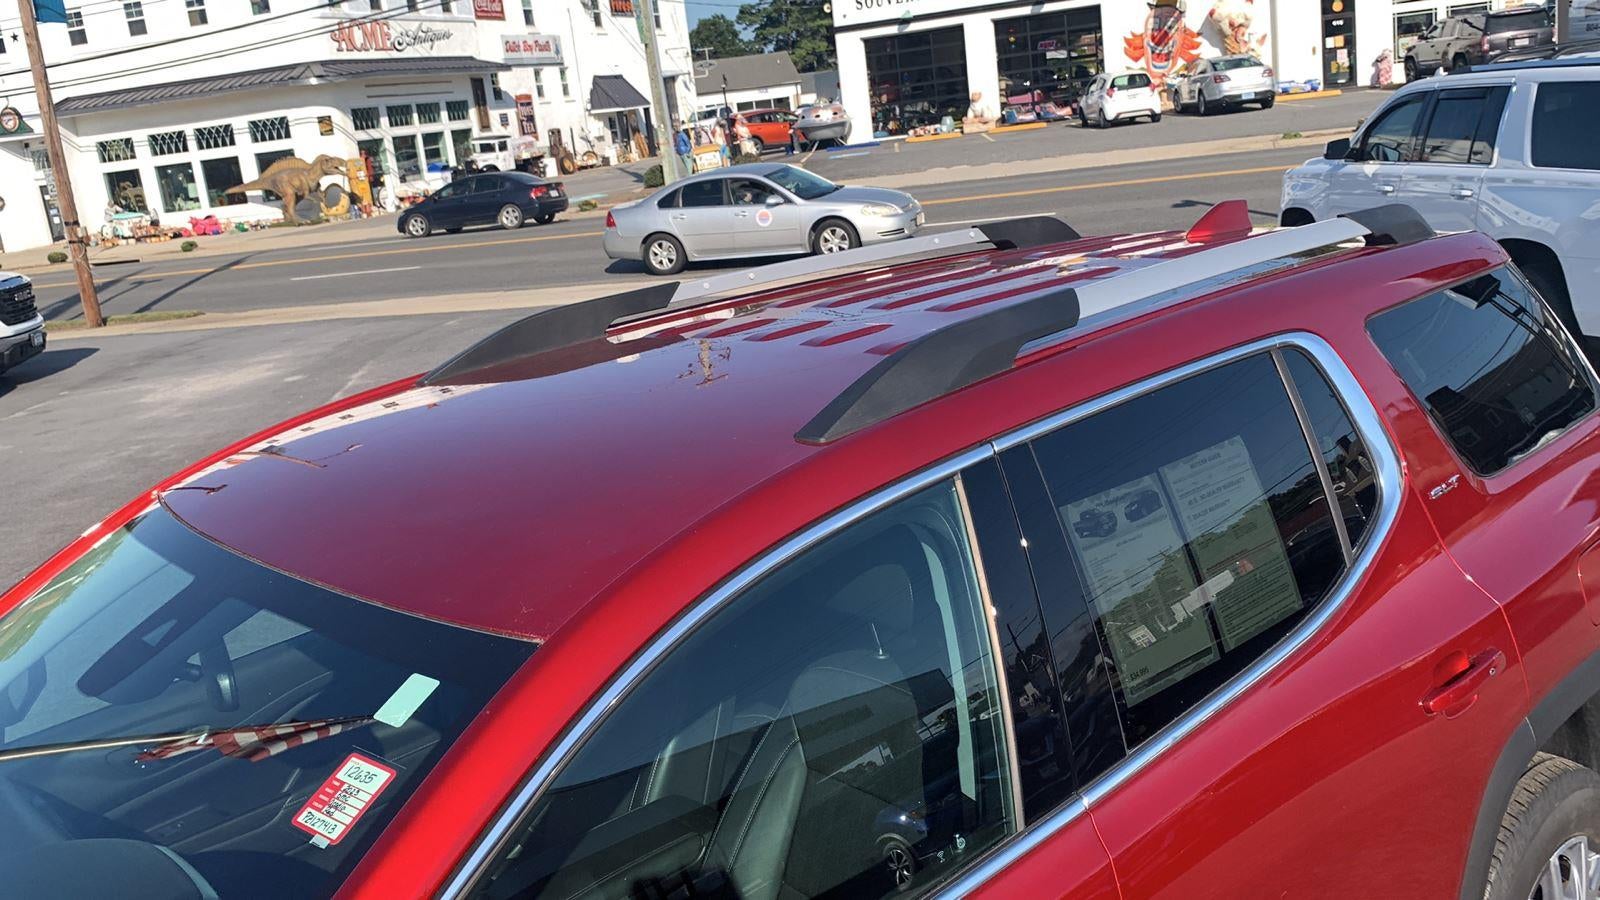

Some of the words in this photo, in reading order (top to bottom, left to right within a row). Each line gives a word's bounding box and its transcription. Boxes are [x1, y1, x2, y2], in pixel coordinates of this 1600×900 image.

[330, 19, 393, 52] ACME
[402, 22, 453, 51] Antiques
[343, 765, 378, 784] 12635
